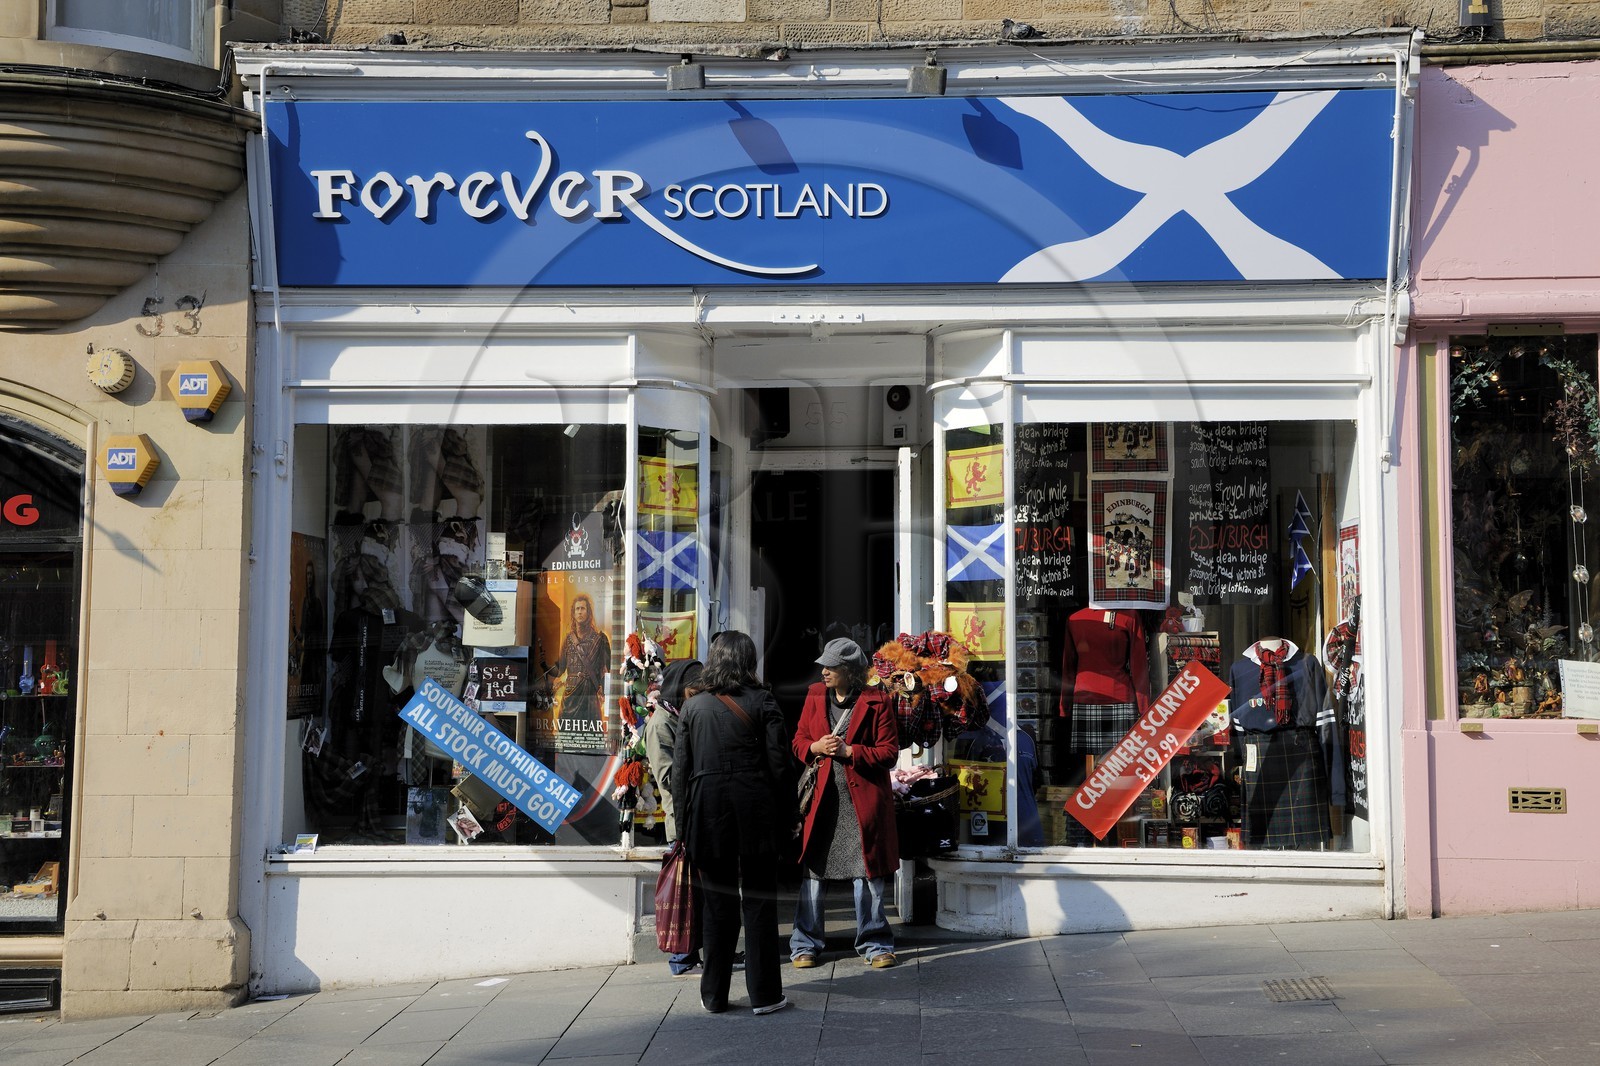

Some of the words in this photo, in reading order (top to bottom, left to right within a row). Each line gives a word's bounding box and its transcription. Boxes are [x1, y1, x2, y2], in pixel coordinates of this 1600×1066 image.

[663, 183, 888, 218] SCOTLAND
[136, 295, 205, 337] 53
[179, 376, 208, 393] ADT
[804, 401, 849, 431] 55
[1019, 425, 1040, 439] dean
[1216, 423, 1236, 437] dean
[1240, 423, 1268, 439] bridge
[107, 452, 136, 468] ADT
[1249, 480, 1268, 498] mile
[0, 494, 40, 526] G
[1106, 498, 1152, 516] EDINBURGH
[1189, 511, 1224, 528] princes
[1189, 524, 1268, 551] EDINBURGH
[551, 559, 602, 571] EDINBURGH
[1022, 554, 1041, 566] dean
[1043, 550, 1072, 570] bridge
[1216, 550, 1238, 564] dean
[1240, 549, 1268, 568] bridge
[568, 574, 614, 584] GIBSON
[1228, 581, 1252, 594] lothian
[419, 682, 485, 738] SOUVENIR
[484, 731, 549, 785] CLOTHING
[543, 777, 579, 809] SALE
[1075, 730, 1148, 810] CASHMERE
[1140, 668, 1201, 737] SCARVES
[407, 703, 439, 733] ALL
[435, 723, 487, 776] STOCK
[484, 760, 532, 802] MUST
[527, 793, 562, 825] GO!
